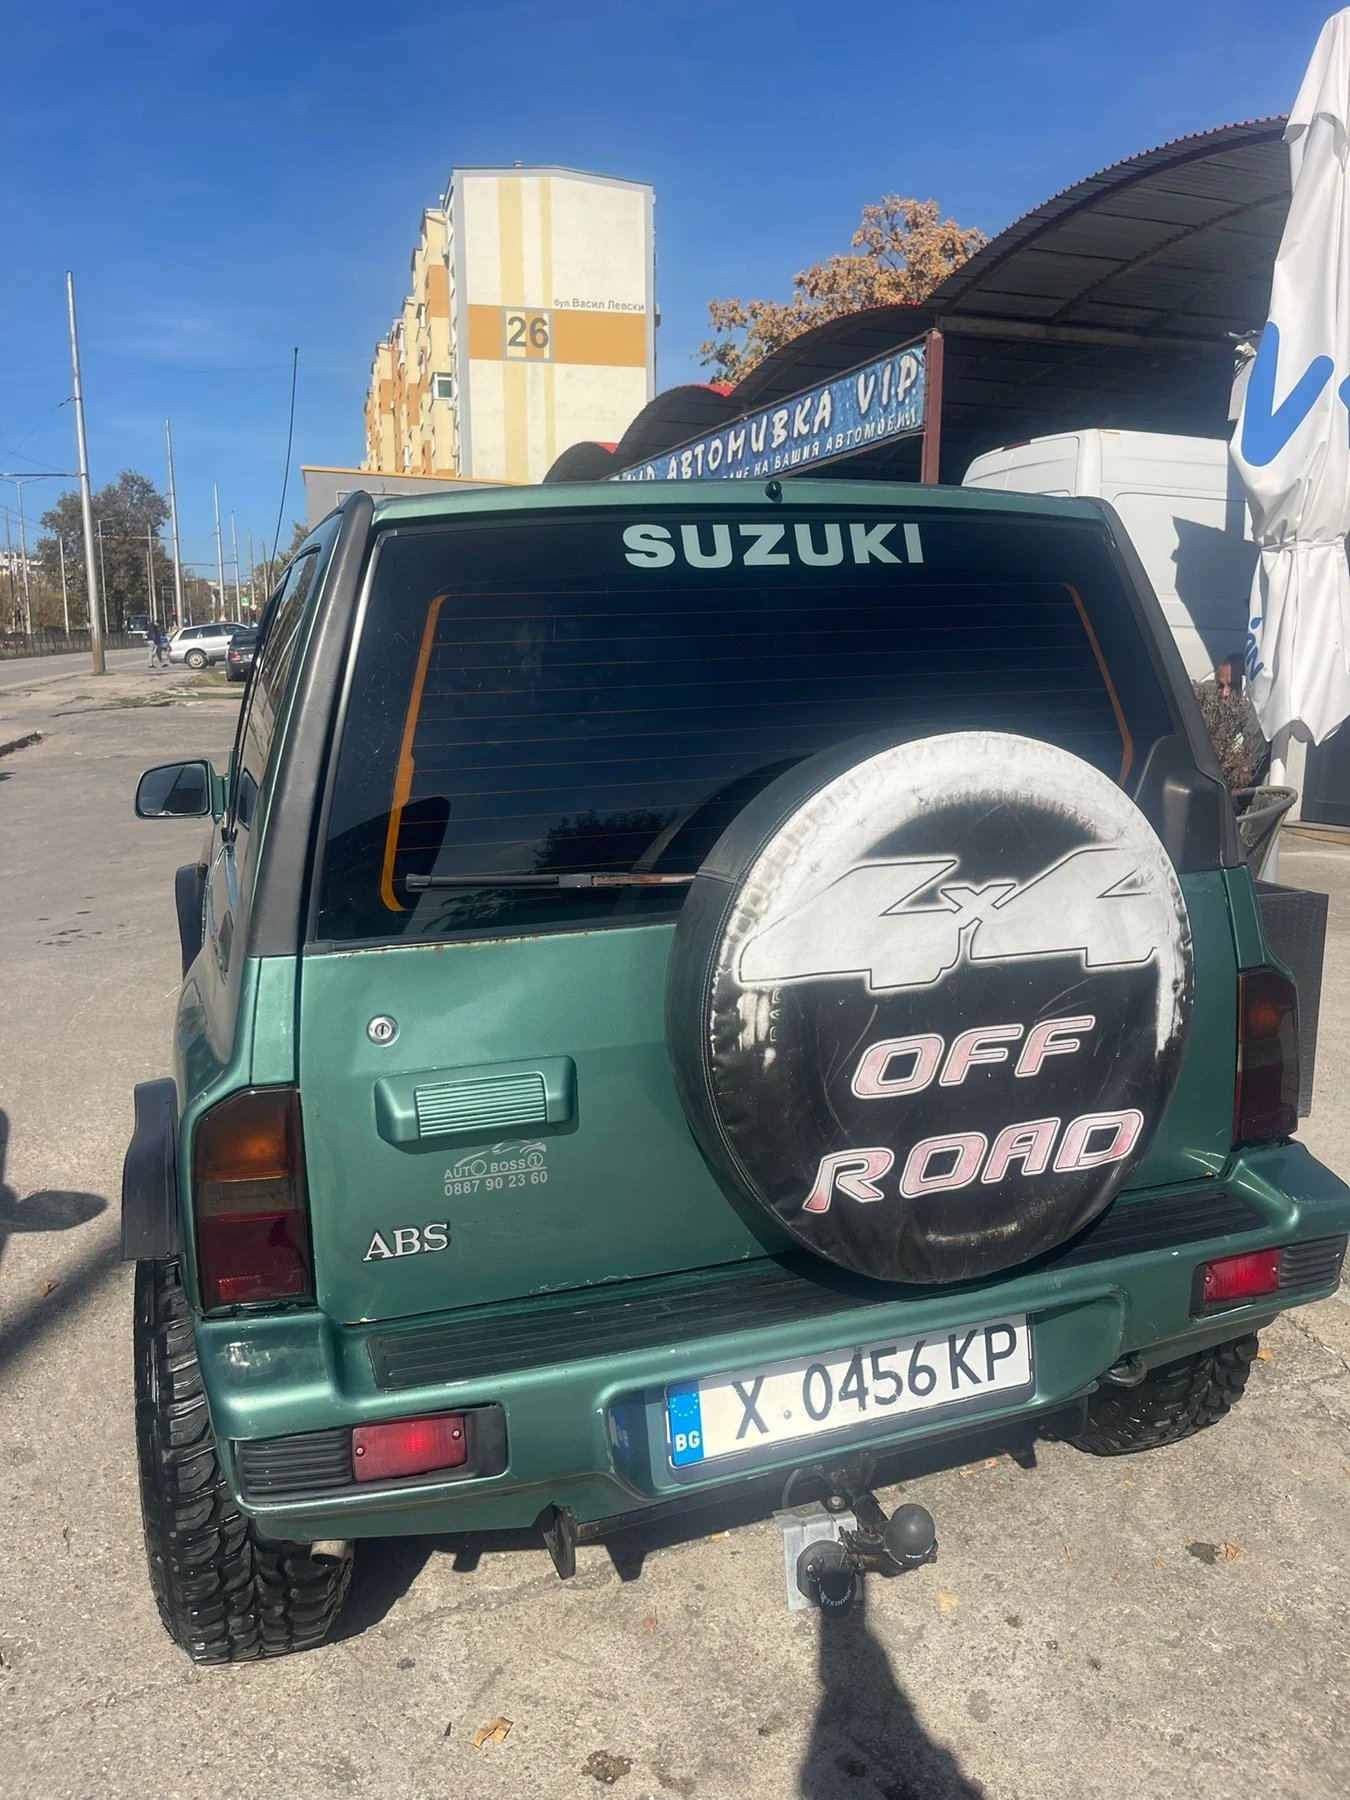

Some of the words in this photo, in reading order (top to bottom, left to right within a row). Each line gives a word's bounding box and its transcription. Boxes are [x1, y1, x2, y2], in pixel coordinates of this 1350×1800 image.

[607, 300, 645, 312] Левски
[507, 316, 548, 349] 26
[857, 355, 917, 415] VIP
[754, 459, 769, 477] НА
[774, 441, 820, 469] ВАШИЯ
[622, 523, 924, 569] SUZUKI
[851, 1015, 1096, 1099] OFF
[444, 1159, 487, 1179] AUTO
[490, 1158, 526, 1173] BOSS
[802, 1109, 1144, 1213] ROAD
[444, 1180, 480, 1196] 0887
[485, 1177, 504, 1191] 90
[508, 1174, 526, 1188] 23
[530, 1171, 548, 1184] 60
[362, 1222, 449, 1262] ABS
[675, 1430, 700, 1453] BG
[731, 1376, 769, 1440] X
[802, 1340, 937, 1421] 0456
[948, 1323, 1017, 1391] KP
